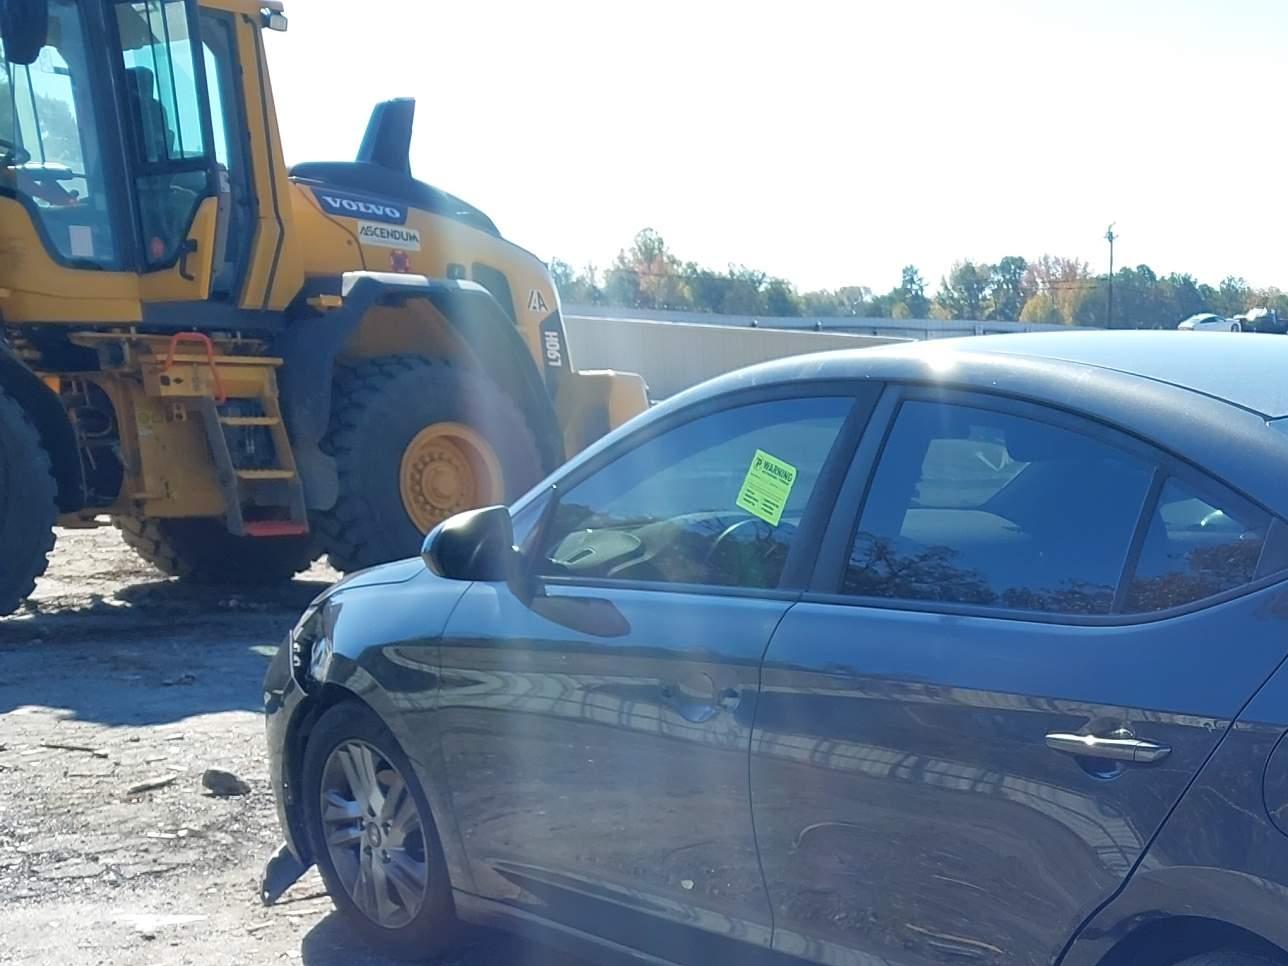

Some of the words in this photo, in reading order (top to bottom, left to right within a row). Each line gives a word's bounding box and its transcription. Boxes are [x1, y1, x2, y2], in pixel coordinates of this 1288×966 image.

[322, 196, 400, 218] VOLVO
[360, 226, 419, 242] ASCENDUM
[544, 331, 562, 367] L90H
[763, 460, 793, 482] WARNING
